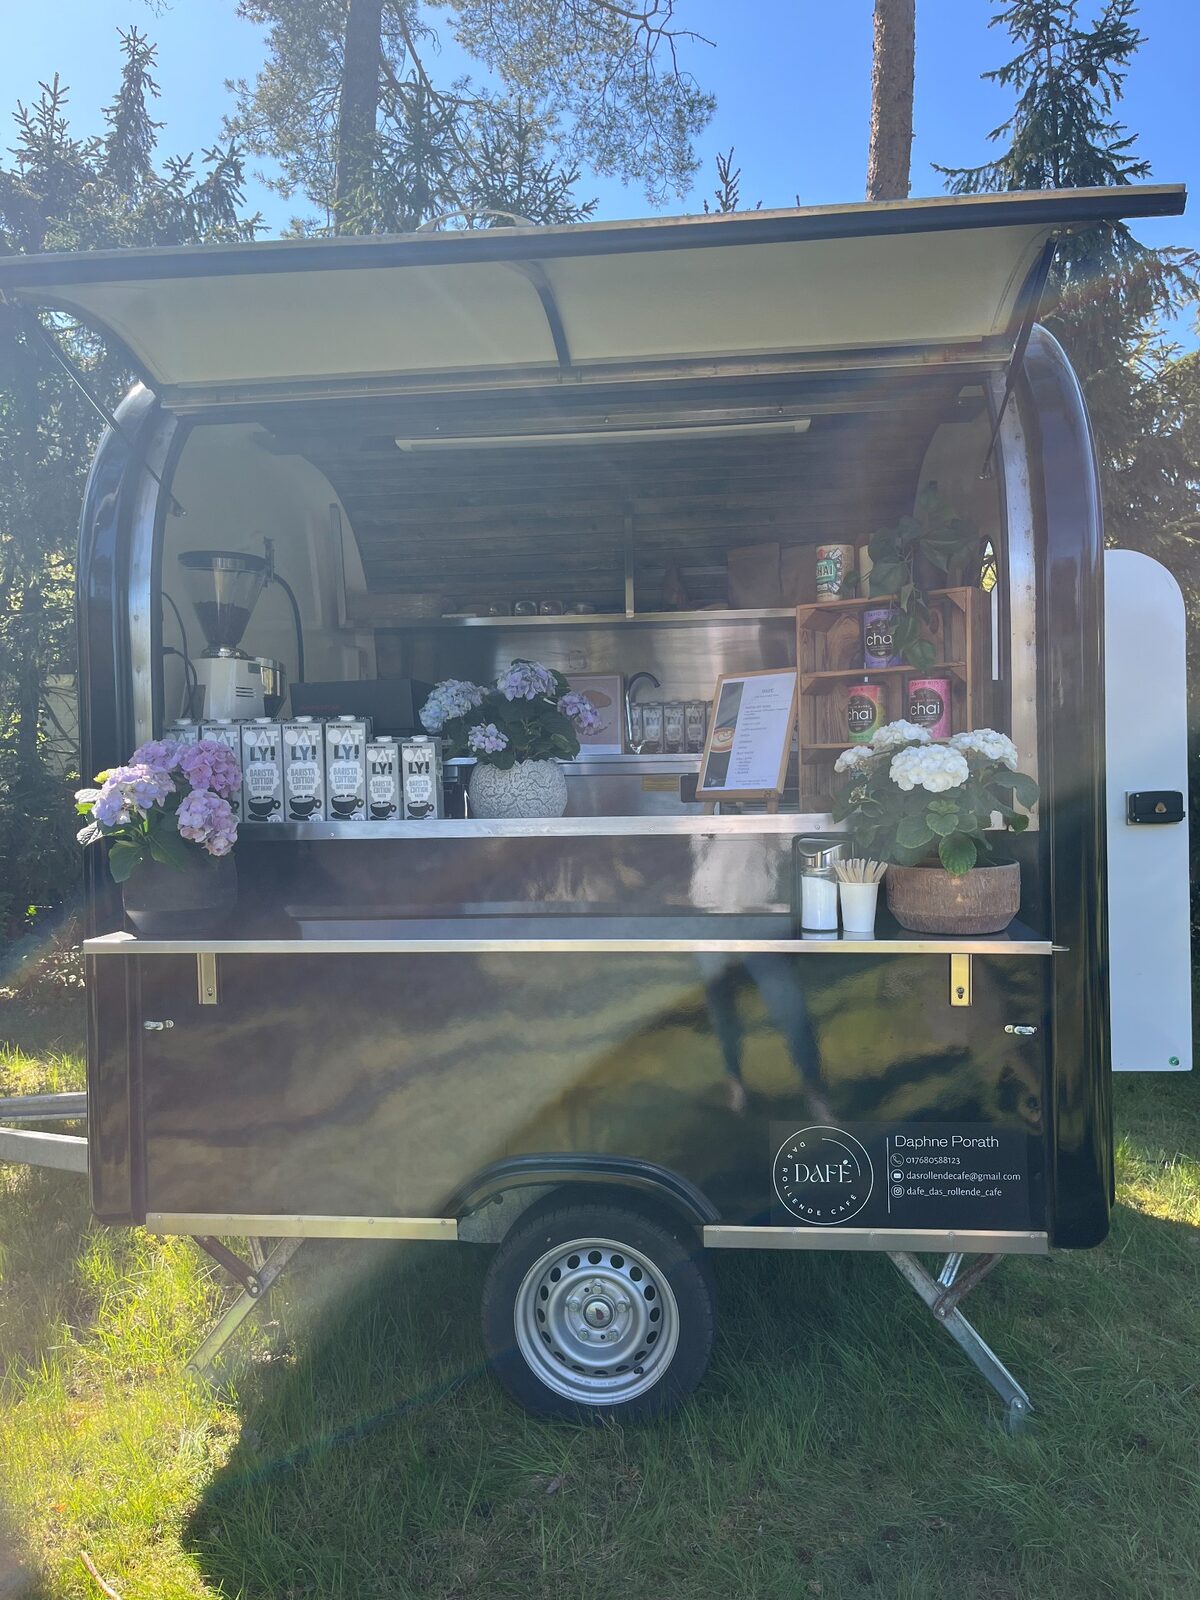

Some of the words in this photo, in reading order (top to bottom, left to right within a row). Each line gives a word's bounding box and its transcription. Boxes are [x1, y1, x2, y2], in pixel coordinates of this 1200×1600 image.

[817, 566, 834, 577] HAI
[866, 632, 892, 646] cha
[911, 701, 940, 716] chai
[243, 730, 279, 746] OAT-
[285, 730, 320, 746] OAT-
[327, 729, 364, 745] OAT-
[250, 746, 276, 762] LY!
[291, 745, 317, 761] LY!
[333, 744, 360, 760] LY!
[367, 749, 396, 762] OAT-
[403, 748, 433, 762] OAT-
[249, 768, 275, 777] BARISTA
[290, 768, 316, 777] BARISTA
[333, 767, 358, 775] BARISTA
[372, 762, 393, 775] LY!
[409, 761, 430, 774] LY!
[251, 777, 274, 785] EDITION
[292, 777, 315, 785] EDITION
[895, 1135, 948, 1150] Daphne
[951, 1135, 999, 1148] Porath
[786, 1141, 806, 1160] DAS
[905, 1156, 961, 1165] 017680588123
[906, 1171, 1021, 1182] dasrollendecafe@gmail.com
[782, 1167, 822, 1216] ROLLENDE
[906, 1186, 1003, 1198] dafe_das_rollende_cafe
